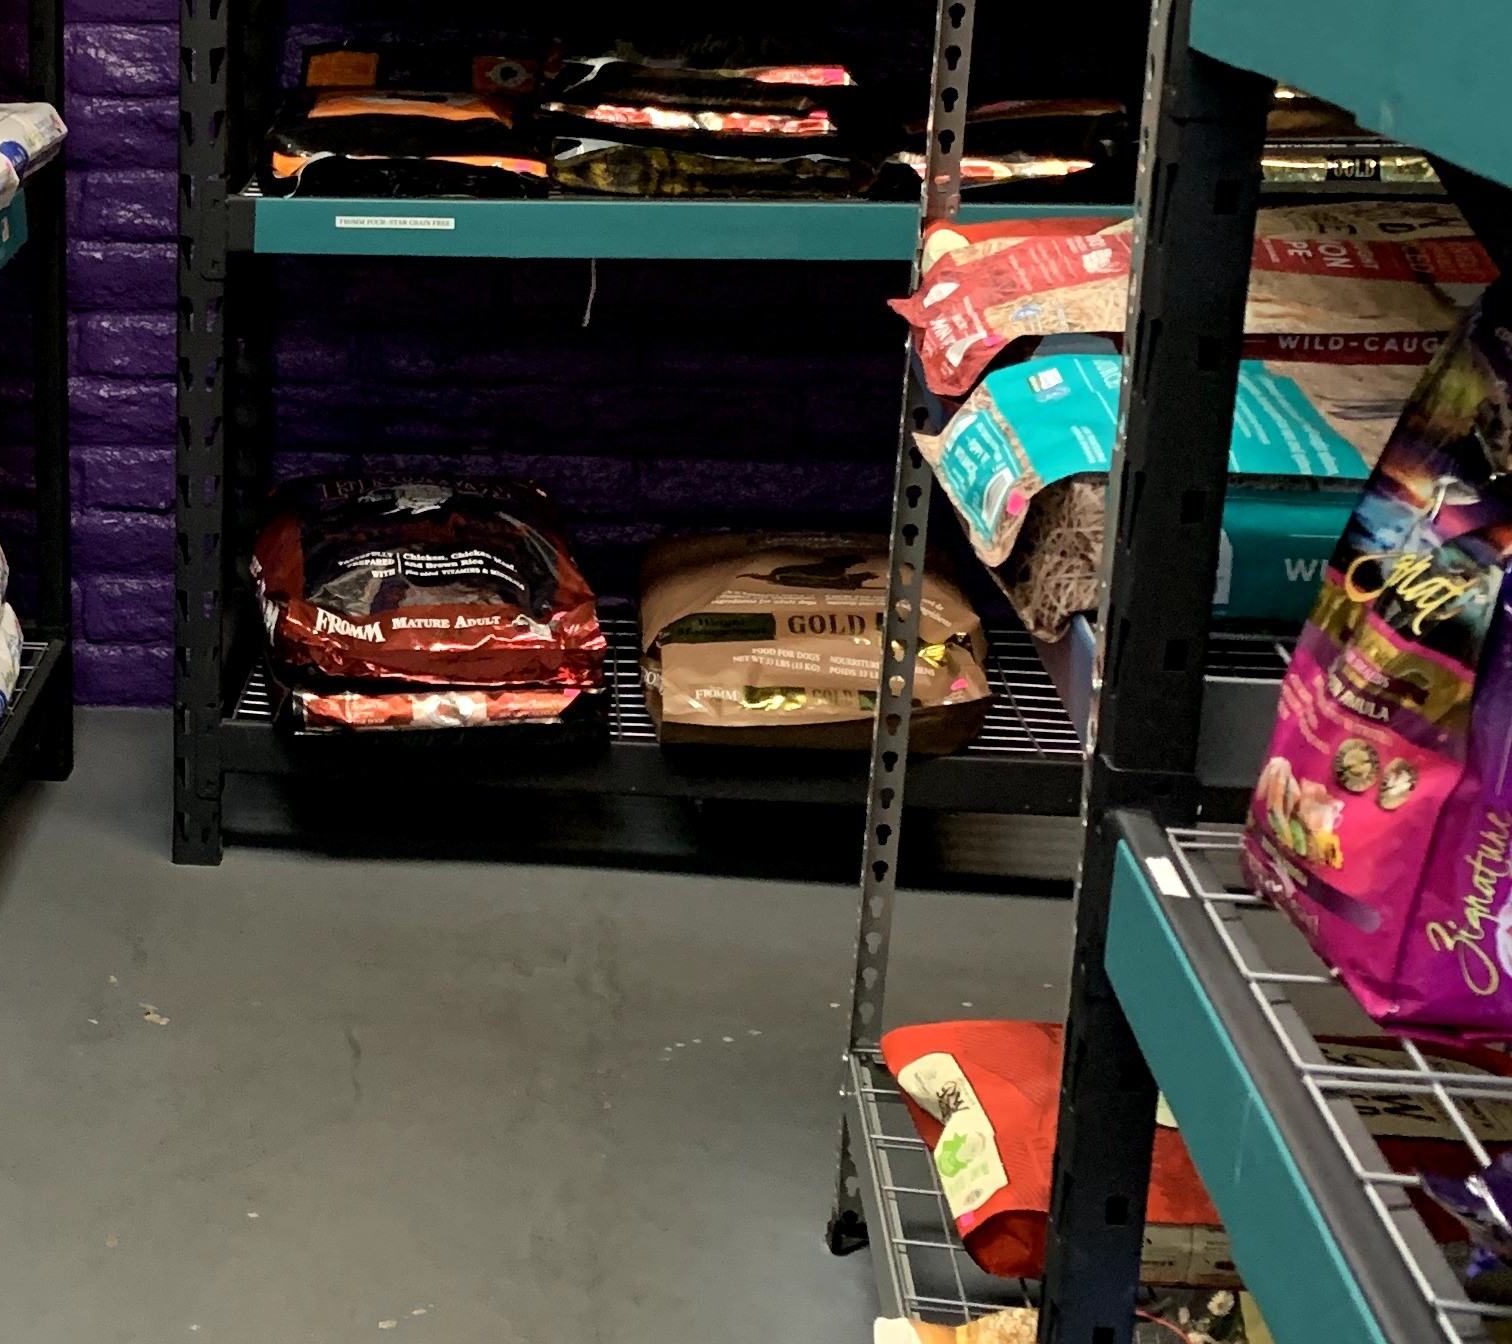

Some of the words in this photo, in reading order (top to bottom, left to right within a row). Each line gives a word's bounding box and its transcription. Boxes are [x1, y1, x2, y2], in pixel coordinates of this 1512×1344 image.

[1278, 334, 1439, 355] WILD-CAUG
[316, 607, 386, 643] FROMM
[787, 612, 867, 637] GOLD
[796, 651, 821, 662] DOGS
